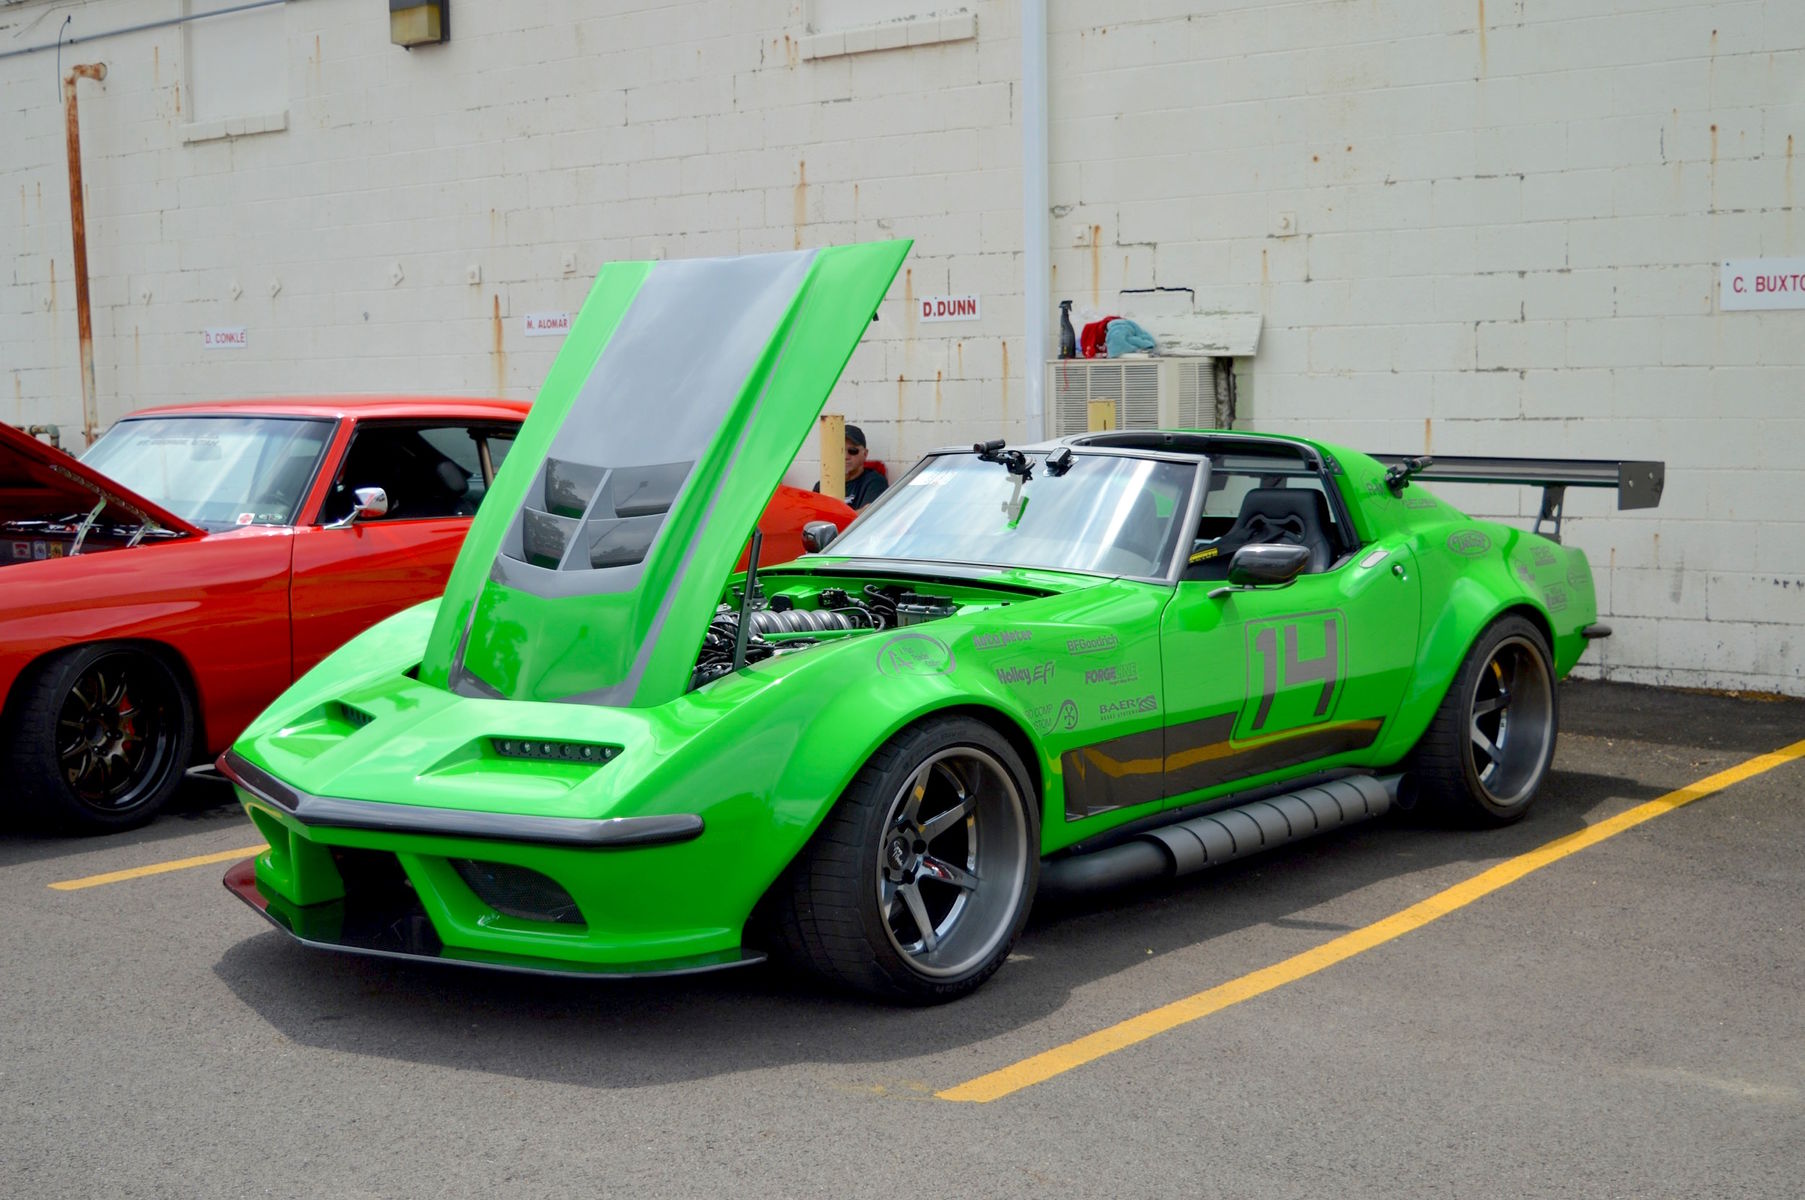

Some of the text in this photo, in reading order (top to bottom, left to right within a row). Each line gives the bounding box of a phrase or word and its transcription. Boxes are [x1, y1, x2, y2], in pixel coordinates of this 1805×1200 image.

[1733, 276, 1747, 293] C.
[923, 299, 976, 317] D.DUNN
[996, 665, 1032, 686] Holley
[1085, 662, 1137, 685] FORGEINE
[1250, 619, 1337, 730] 14
